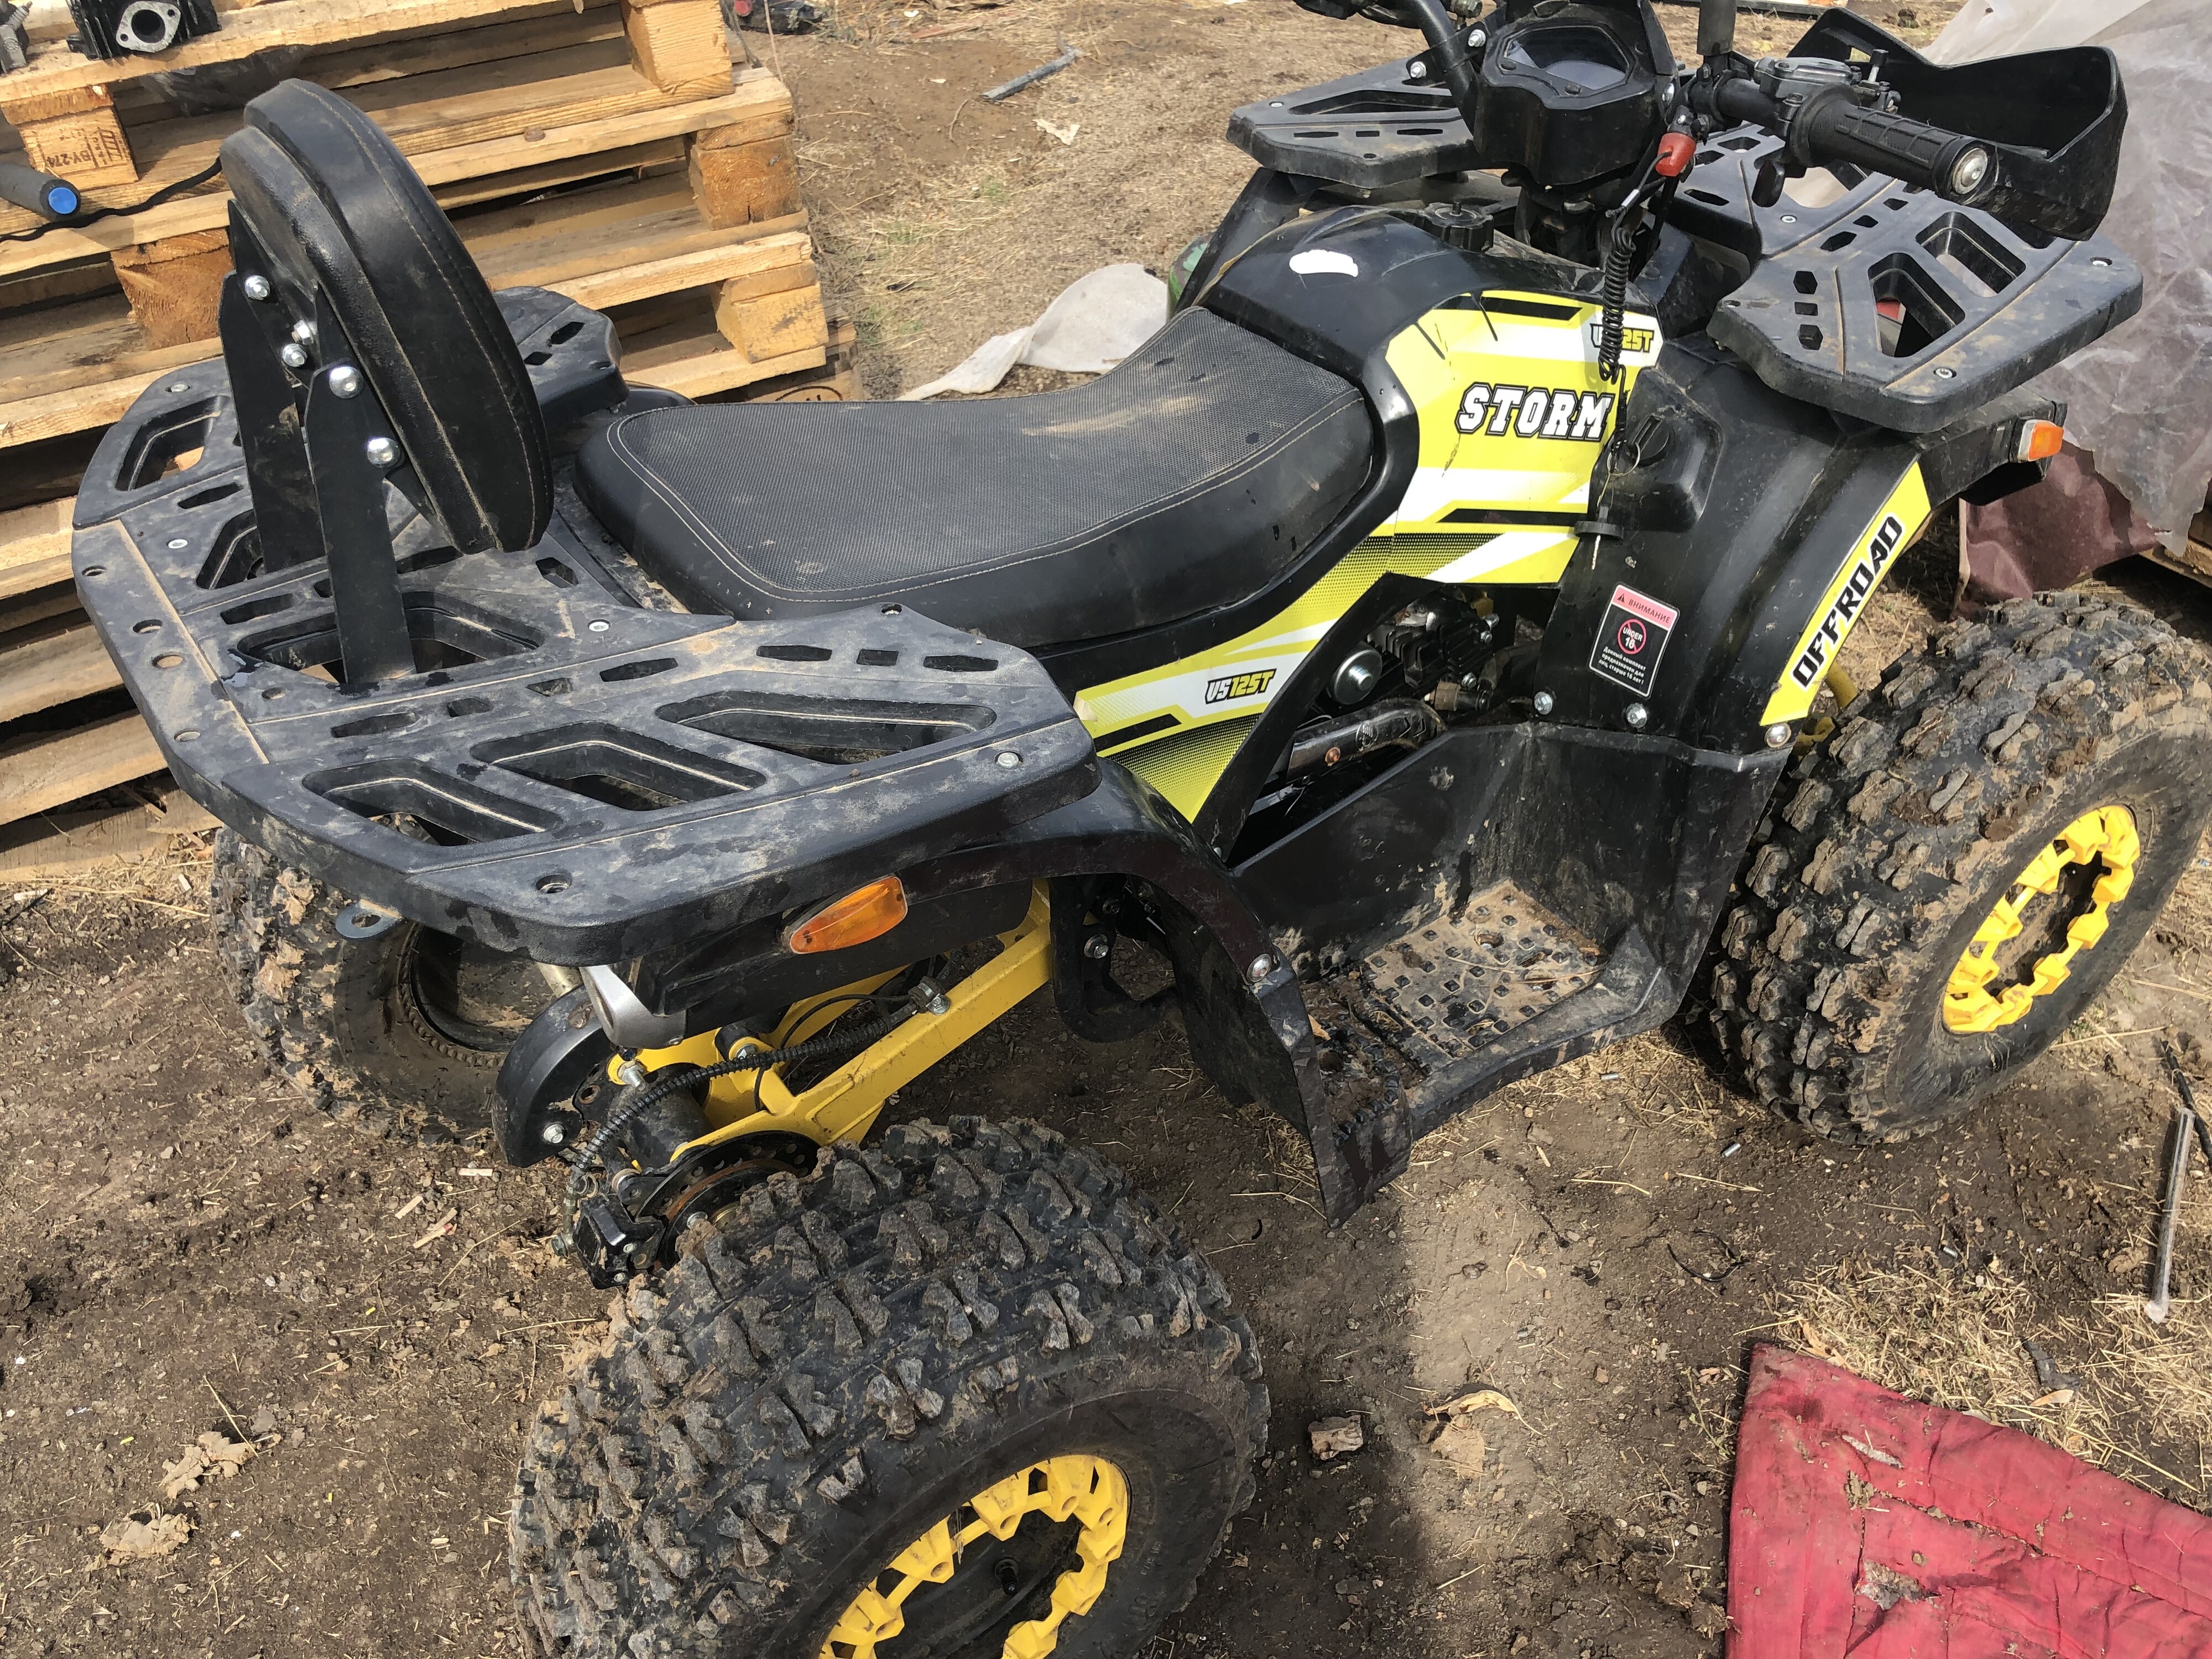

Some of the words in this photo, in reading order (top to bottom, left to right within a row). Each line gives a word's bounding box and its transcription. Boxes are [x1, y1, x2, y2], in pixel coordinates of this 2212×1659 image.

[46, 149, 92, 168] BY-274
[1454, 382, 1616, 441] STORM
[1629, 598, 1671, 624] ВНИМАНИЕ
[1792, 516, 1902, 688] OFFROAD
[1623, 627, 1643, 642] UNDER
[1625, 637, 1635, 649] 16
[1601, 653, 1634, 673] предназначен
[1634, 670, 1644, 678] для
[1603, 645, 1623, 660] Данный
[1623, 656, 1646, 671] комплект
[1609, 664, 1626, 676] старше
